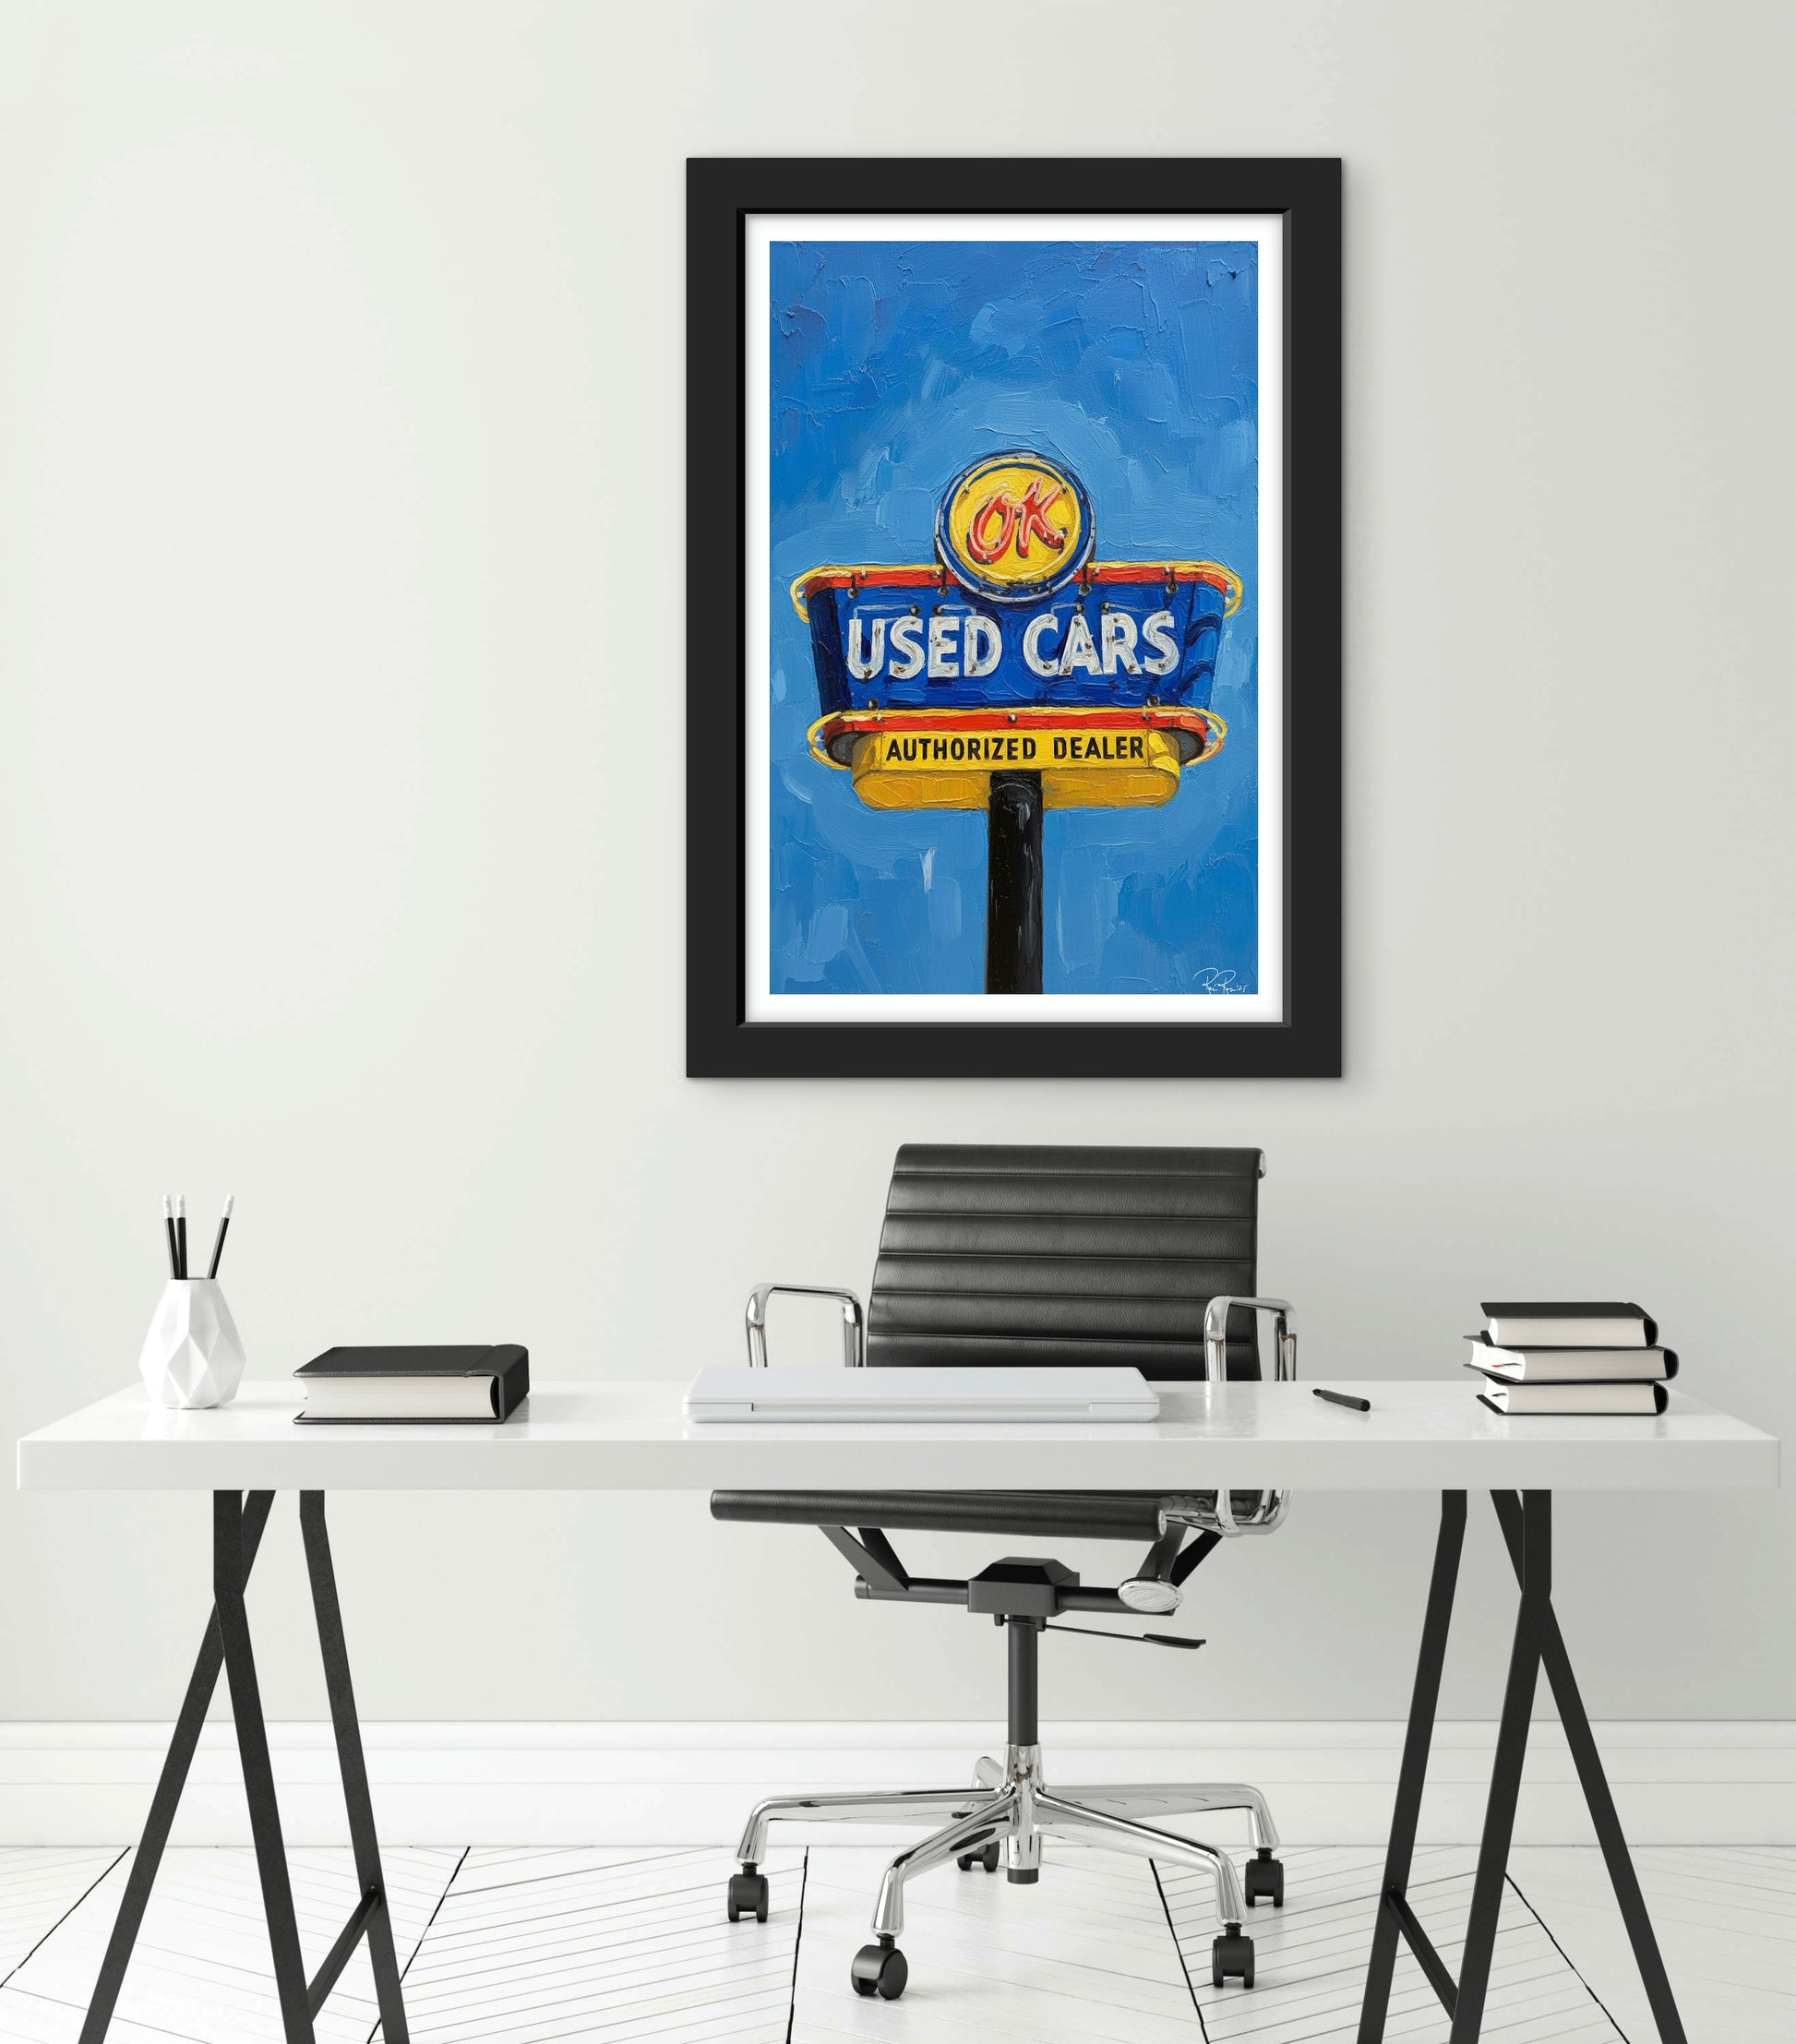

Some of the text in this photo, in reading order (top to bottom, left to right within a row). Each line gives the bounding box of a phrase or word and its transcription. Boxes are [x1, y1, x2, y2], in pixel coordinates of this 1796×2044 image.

[966, 476, 1067, 565] OK
[847, 611, 1180, 680] USED CARS
[885, 735, 1144, 762] AUTHORIZED DEALER
